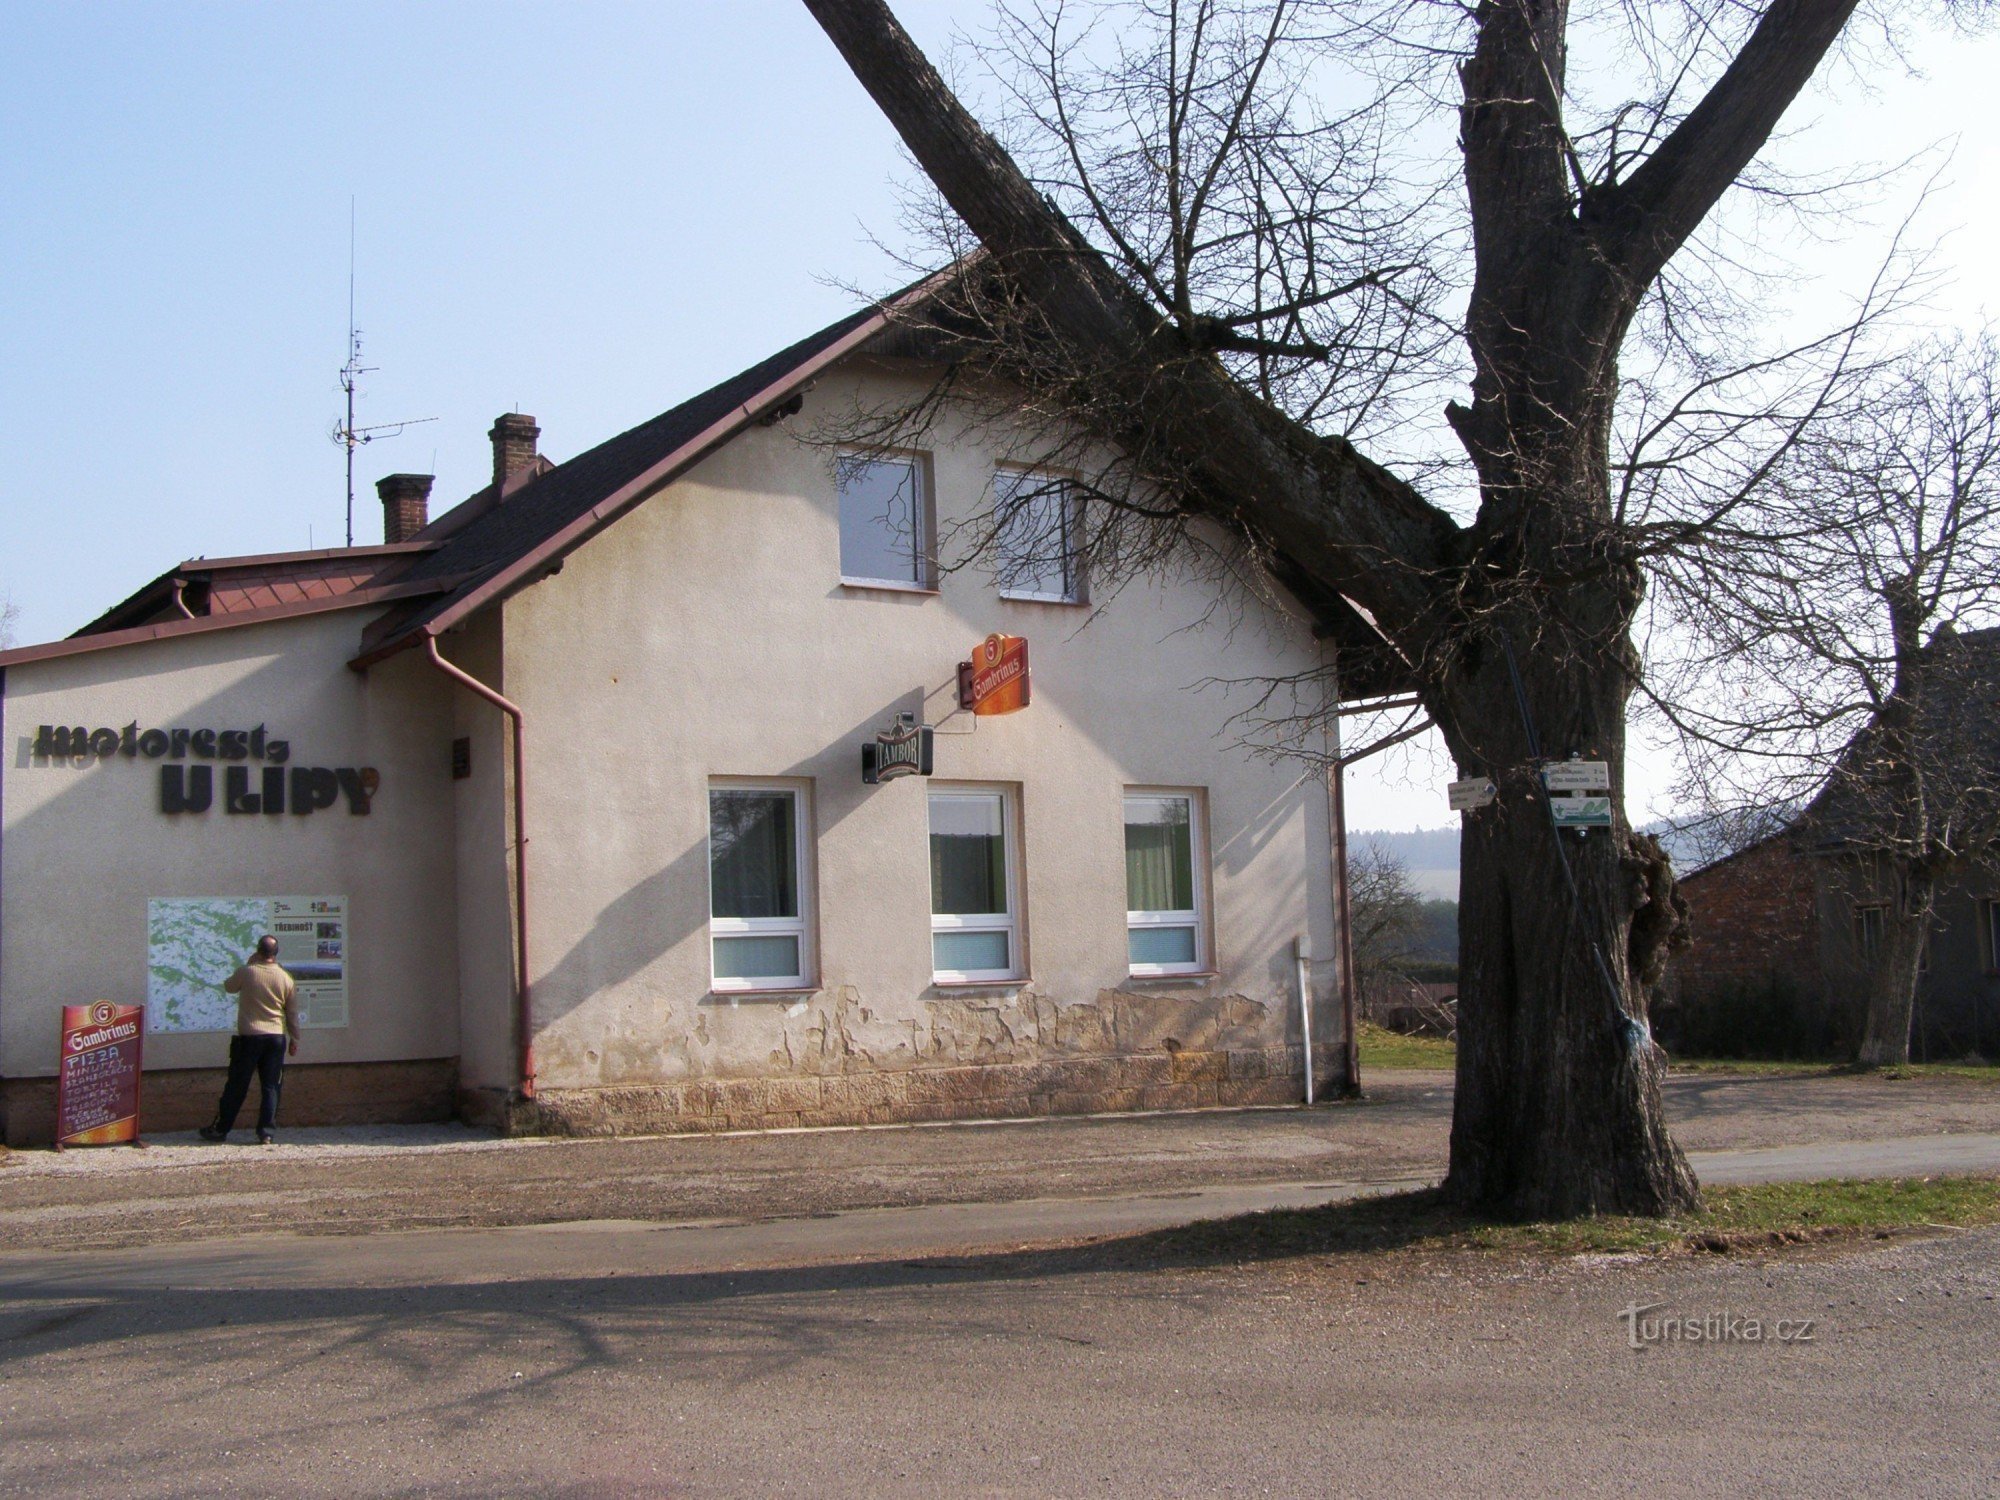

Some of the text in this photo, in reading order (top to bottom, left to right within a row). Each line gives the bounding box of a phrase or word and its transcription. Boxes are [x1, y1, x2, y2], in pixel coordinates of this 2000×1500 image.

[974, 658, 1020, 700] Gambrinus
[33, 720, 269, 760] motorest
[878, 737, 918, 769] TAMBOR
[161, 764, 212, 814] U
[71, 1022, 137, 1051] Gambrinus
[67, 1046, 119, 1069] PIZZA
